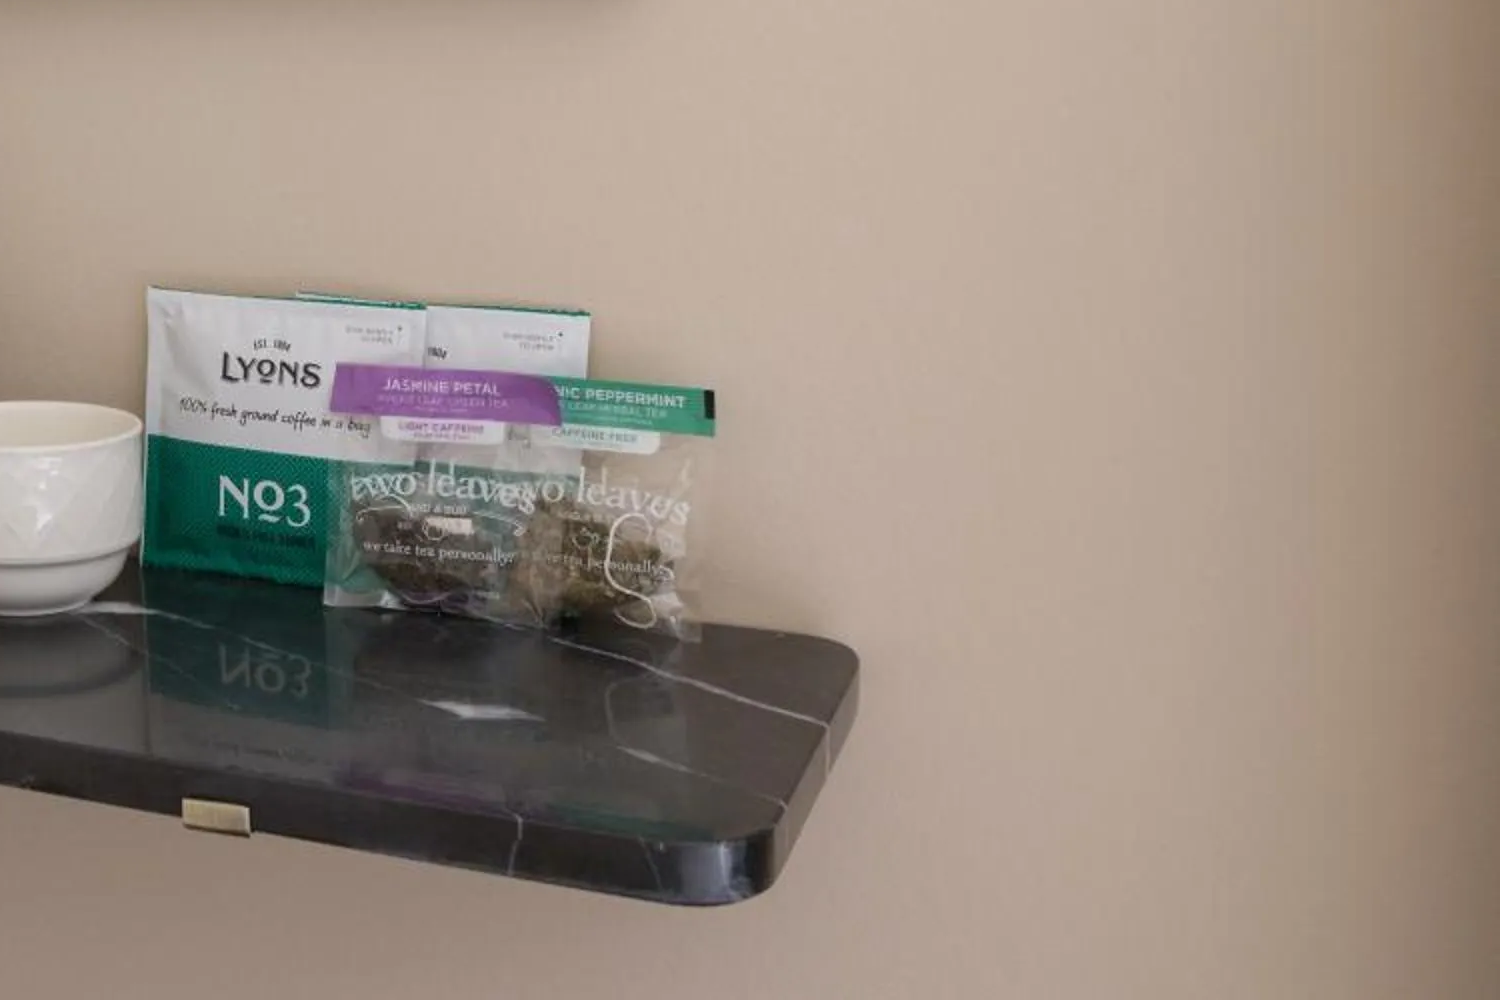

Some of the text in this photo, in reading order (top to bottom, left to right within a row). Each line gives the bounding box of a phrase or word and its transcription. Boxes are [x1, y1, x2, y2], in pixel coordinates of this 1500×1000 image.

[220, 351, 323, 389] LYONS
[383, 377, 501, 396] JASMINE PETAL
[585, 388, 687, 409] PEPPERMINT
[210, 401, 238, 420] fresh
[240, 408, 280, 426] ground
[280, 411, 317, 432] coffee
[347, 417, 372, 439] bag
[383, 542, 412, 556] take
[415, 545, 437, 558] tea
